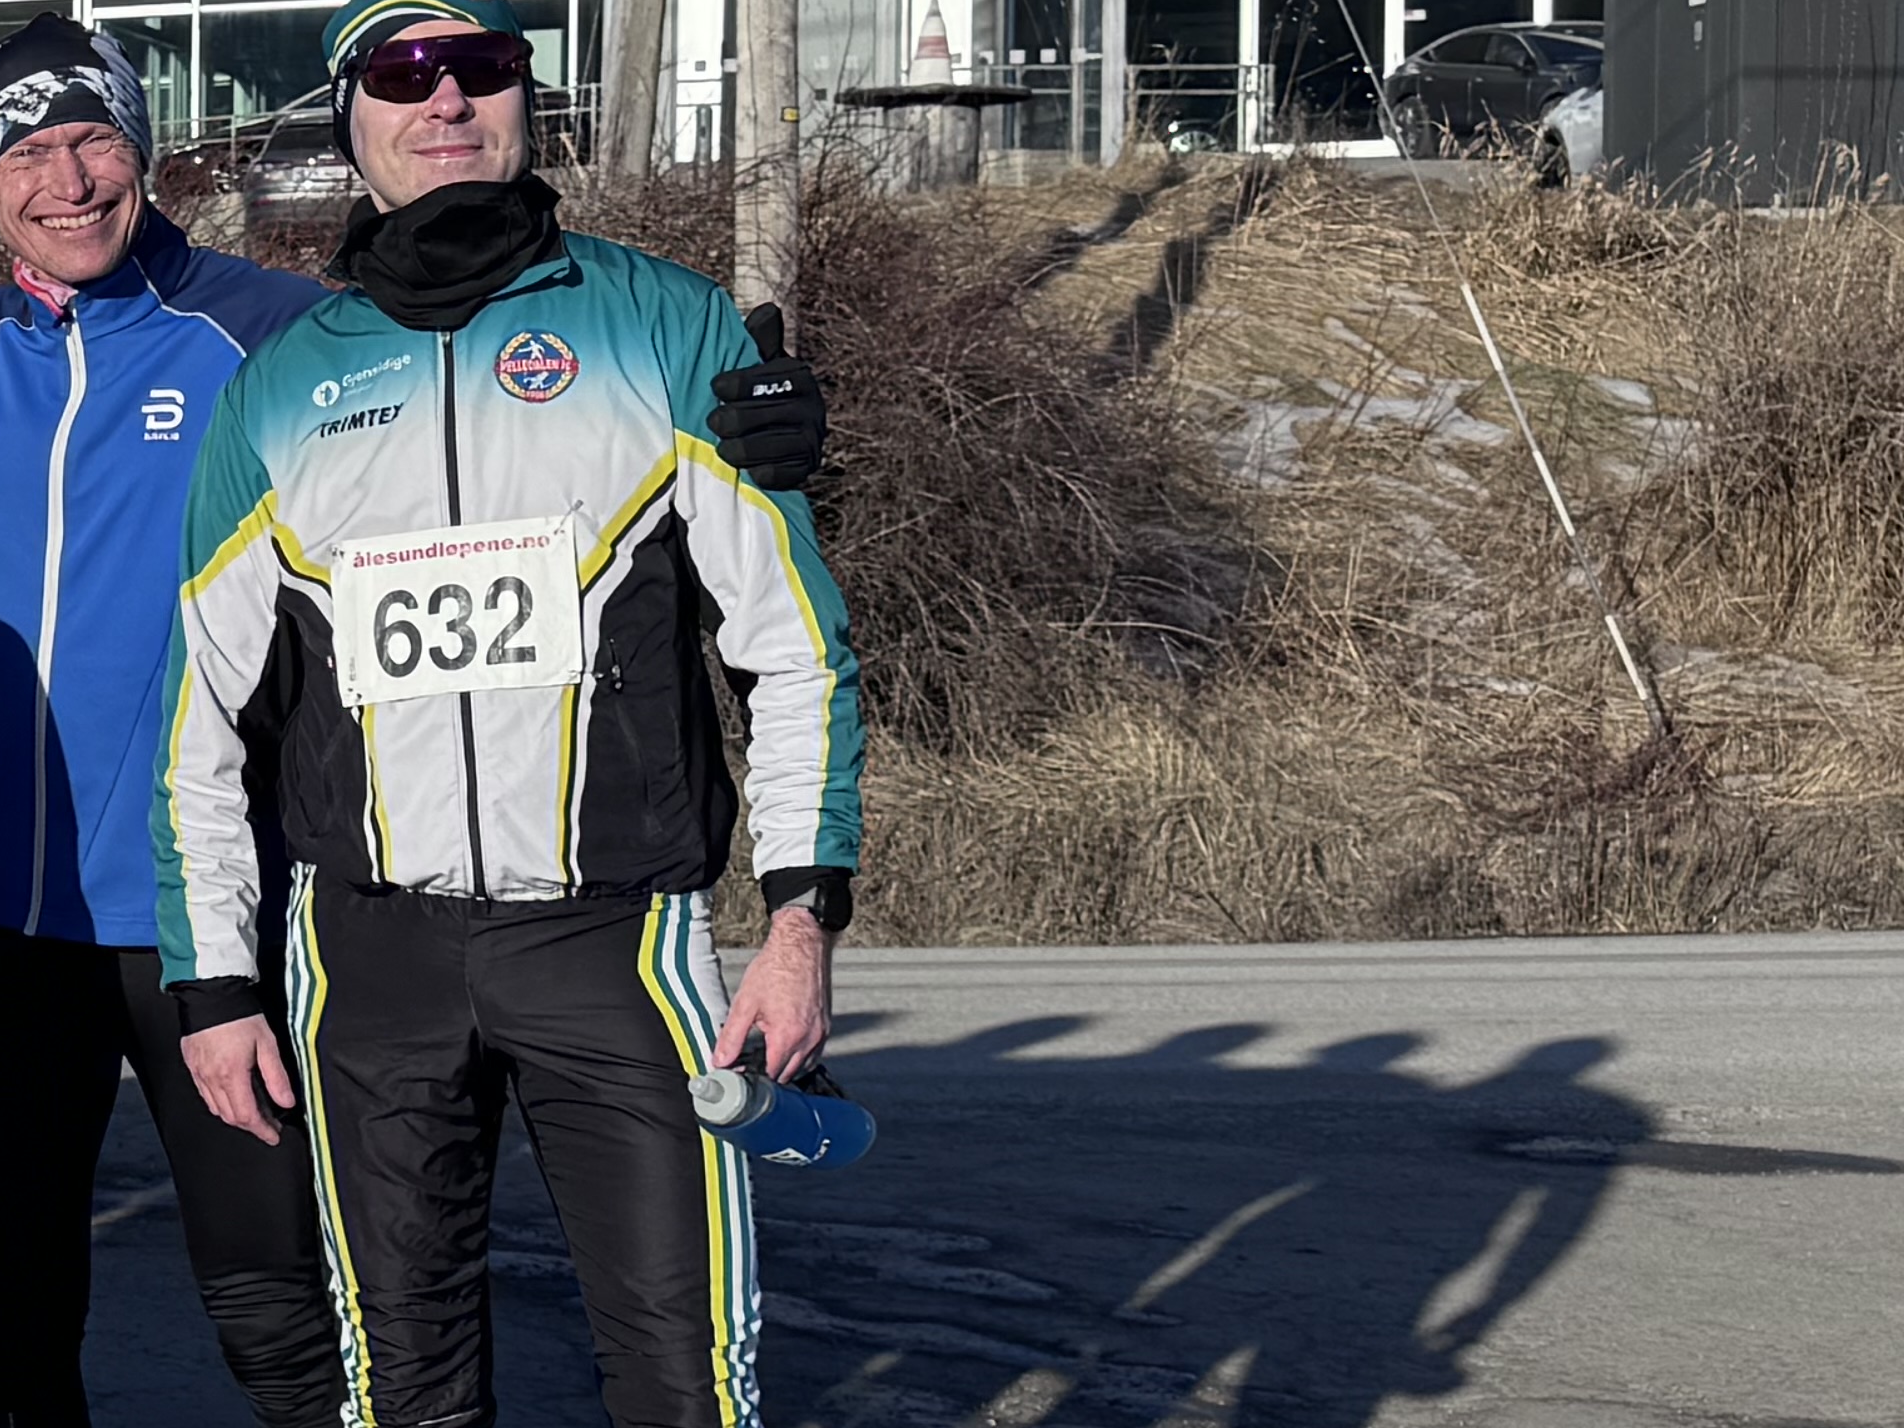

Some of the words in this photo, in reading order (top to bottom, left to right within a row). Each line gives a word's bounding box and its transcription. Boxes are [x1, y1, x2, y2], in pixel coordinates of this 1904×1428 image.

[320, 402, 404, 439] TRIMTEX
[353, 534, 550, 568] ålesundløpene.no
[373, 576, 536, 678] 632
